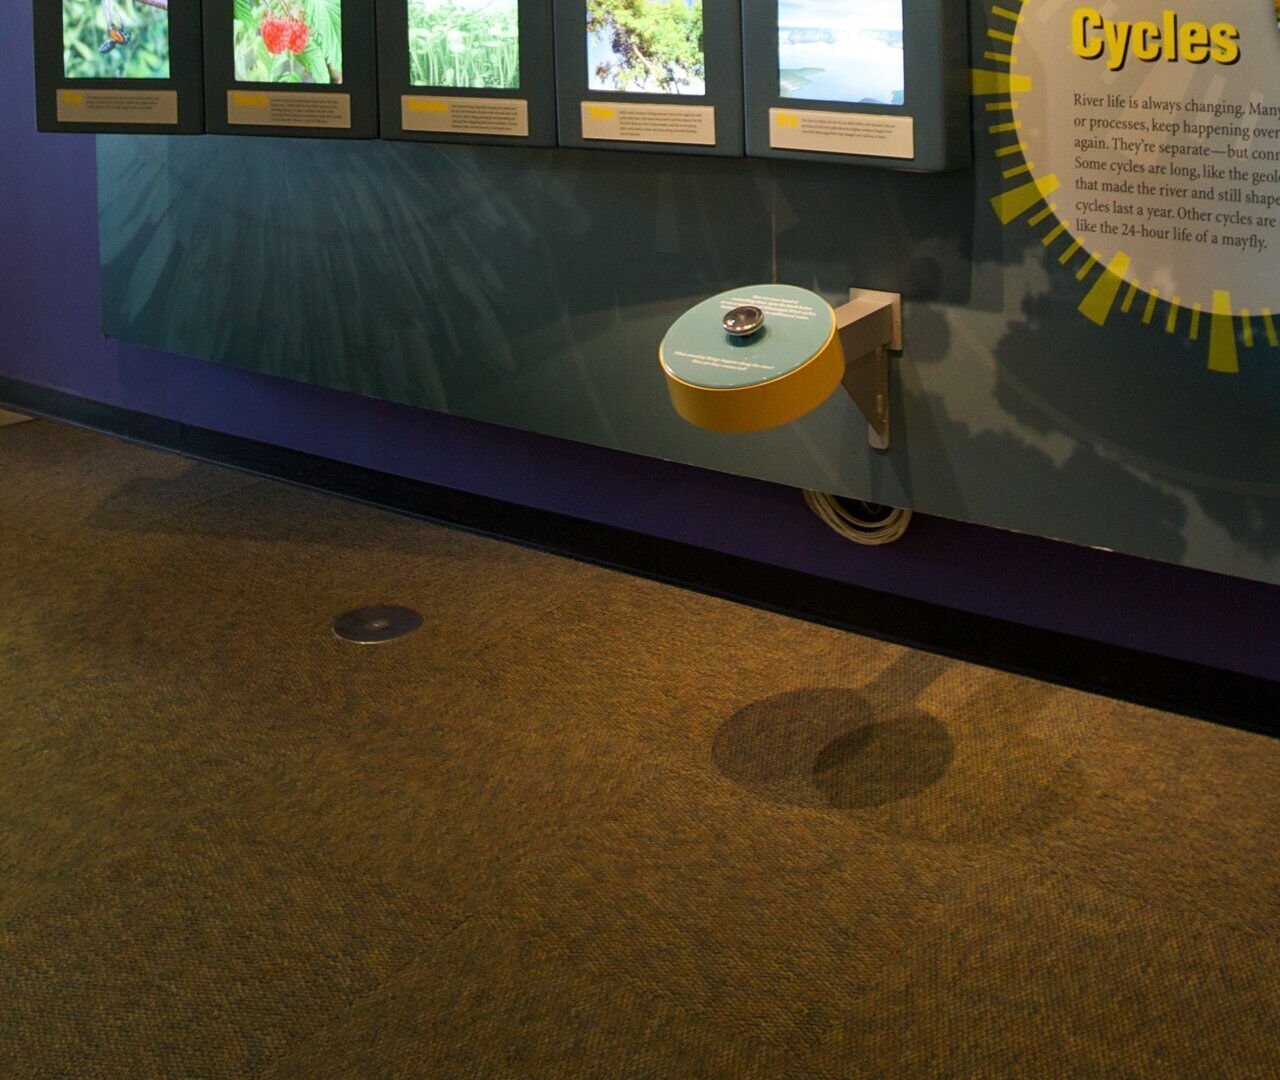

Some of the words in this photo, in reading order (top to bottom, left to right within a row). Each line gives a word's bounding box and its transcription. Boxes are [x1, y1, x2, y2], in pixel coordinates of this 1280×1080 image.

[1071, 7, 1240, 71] Cycles
[1074, 93, 1104, 107] River
[1107, 94, 1126, 108] life
[1129, 96, 1139, 109] is
[1142, 96, 1181, 114] always
[1185, 98, 1246, 118] changing.
[1074, 117, 1086, 126] or
[1090, 118, 1149, 132] processes,
[1152, 118, 1179, 136] keep
[1183, 120, 1250, 140] happening
[1253, 128, 1280, 138] over
[1074, 137, 1109, 152] again.
[1075, 156, 1107, 170] Some
[1110, 159, 1145, 175] cycles
[1148, 164, 1167, 175] are
[1170, 162, 1200, 181] long,
[1203, 164, 1225, 180] like
[1229, 167, 1249, 181] the
[1075, 177, 1098, 191] that
[1101, 180, 1134, 194] made
[1137, 181, 1156, 195] the
[1159, 184, 1188, 198] river
[1191, 187, 1214, 200] and
[1218, 189, 1241, 202] still
[1075, 199, 1110, 215] cycles
[1113, 200, 1133, 215] last
[1136, 206, 1144, 216] a
[1147, 207, 1175, 220] year.
[1177, 206, 1212, 222] Other
[1215, 211, 1253, 227] cycles
[1256, 217, 1277, 227] are
[1076, 218, 1097, 233] like
[1100, 221, 1119, 235] the
[1121, 223, 1170, 240] 24-hour
[1173, 226, 1193, 242] life
[1195, 229, 1209, 244] of
[1211, 234, 1218, 244] a
[1222, 233, 1267, 253] mayfly.
